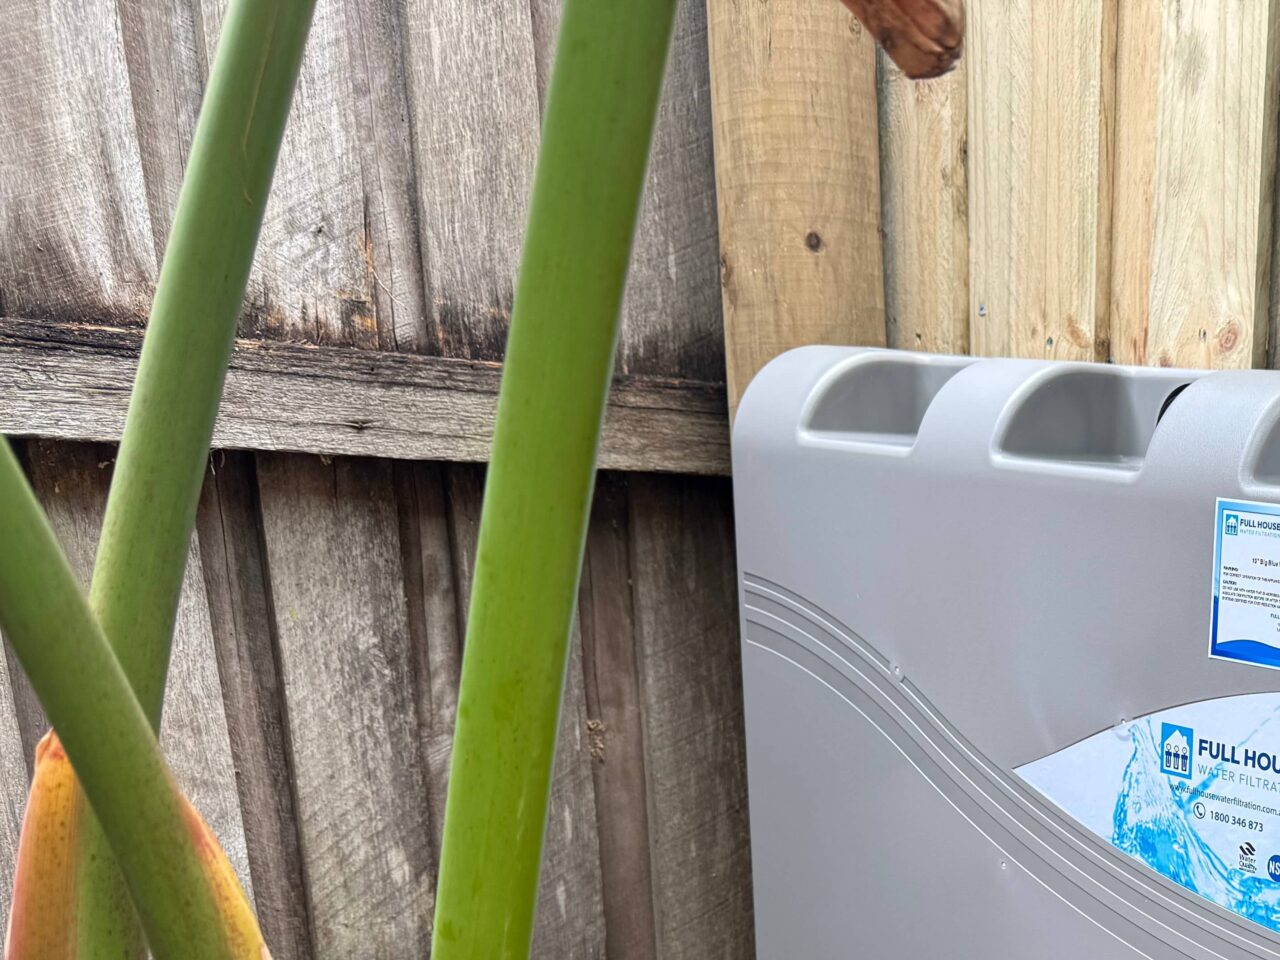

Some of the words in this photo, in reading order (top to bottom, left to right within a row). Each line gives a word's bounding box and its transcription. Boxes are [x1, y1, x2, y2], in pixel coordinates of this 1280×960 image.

[1240, 518, 1256, 528] FULL
[1257, 521, 1280, 531] HOUSE
[1260, 559, 1268, 567] Big
[1198, 738, 1240, 764] FULL
[1198, 763, 1235, 782] WATER
[1210, 810, 1229, 824] 1800
[1231, 816, 1247, 828] 346
[1248, 820, 1264, 832] 873
